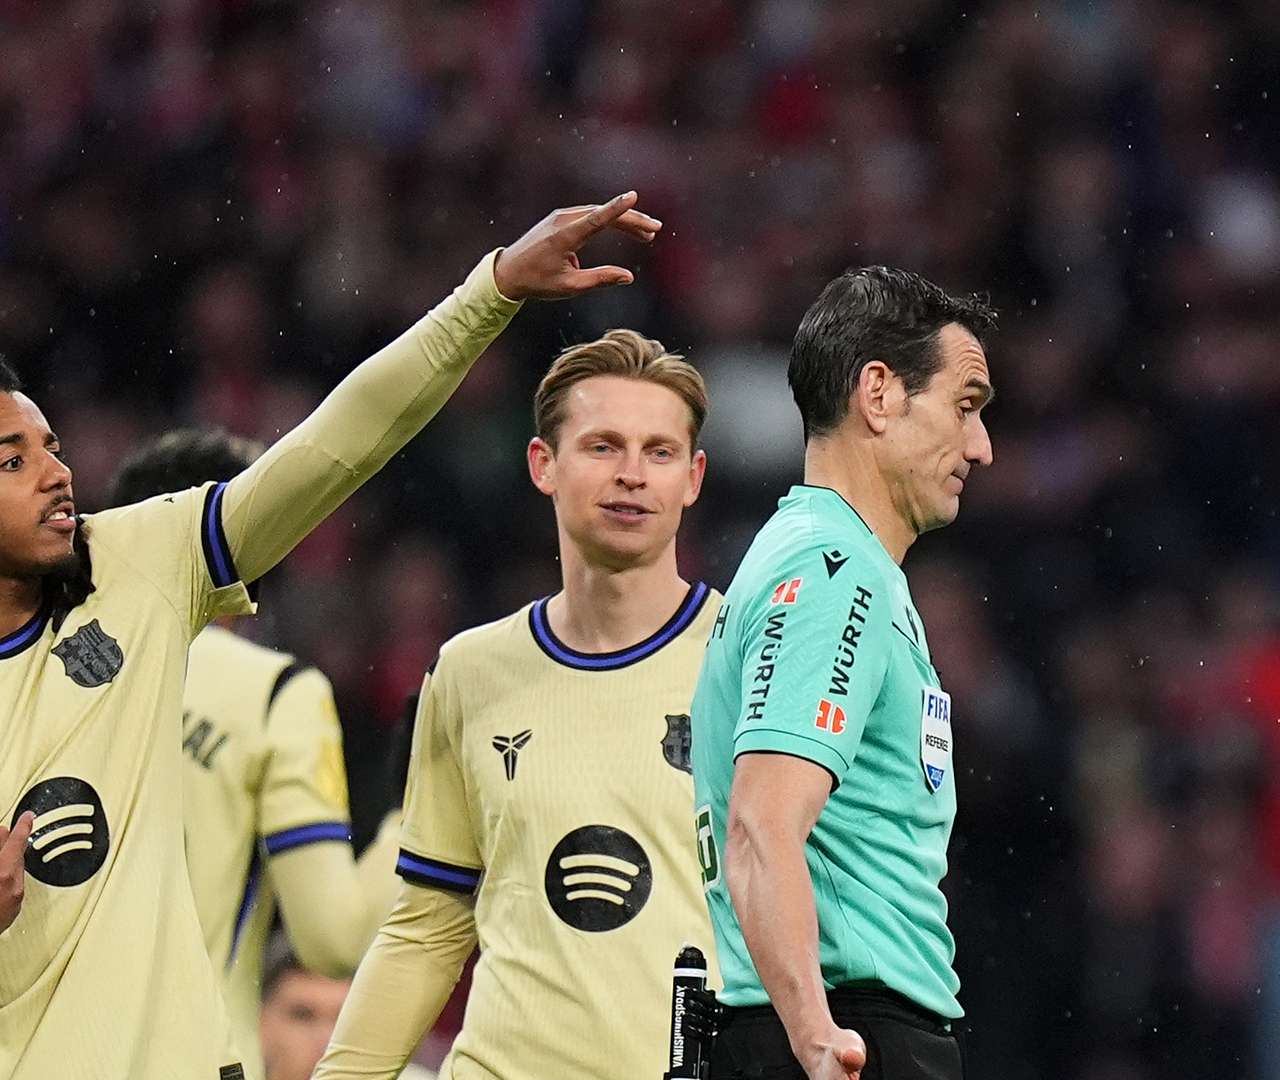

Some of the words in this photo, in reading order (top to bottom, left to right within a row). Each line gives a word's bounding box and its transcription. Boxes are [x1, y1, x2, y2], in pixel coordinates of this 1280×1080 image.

[747, 611, 788, 722] WÜRTH
[829, 585, 873, 697] WÜRTH
[181, 710, 230, 771] AL
[927, 693, 949, 724] FIFA
